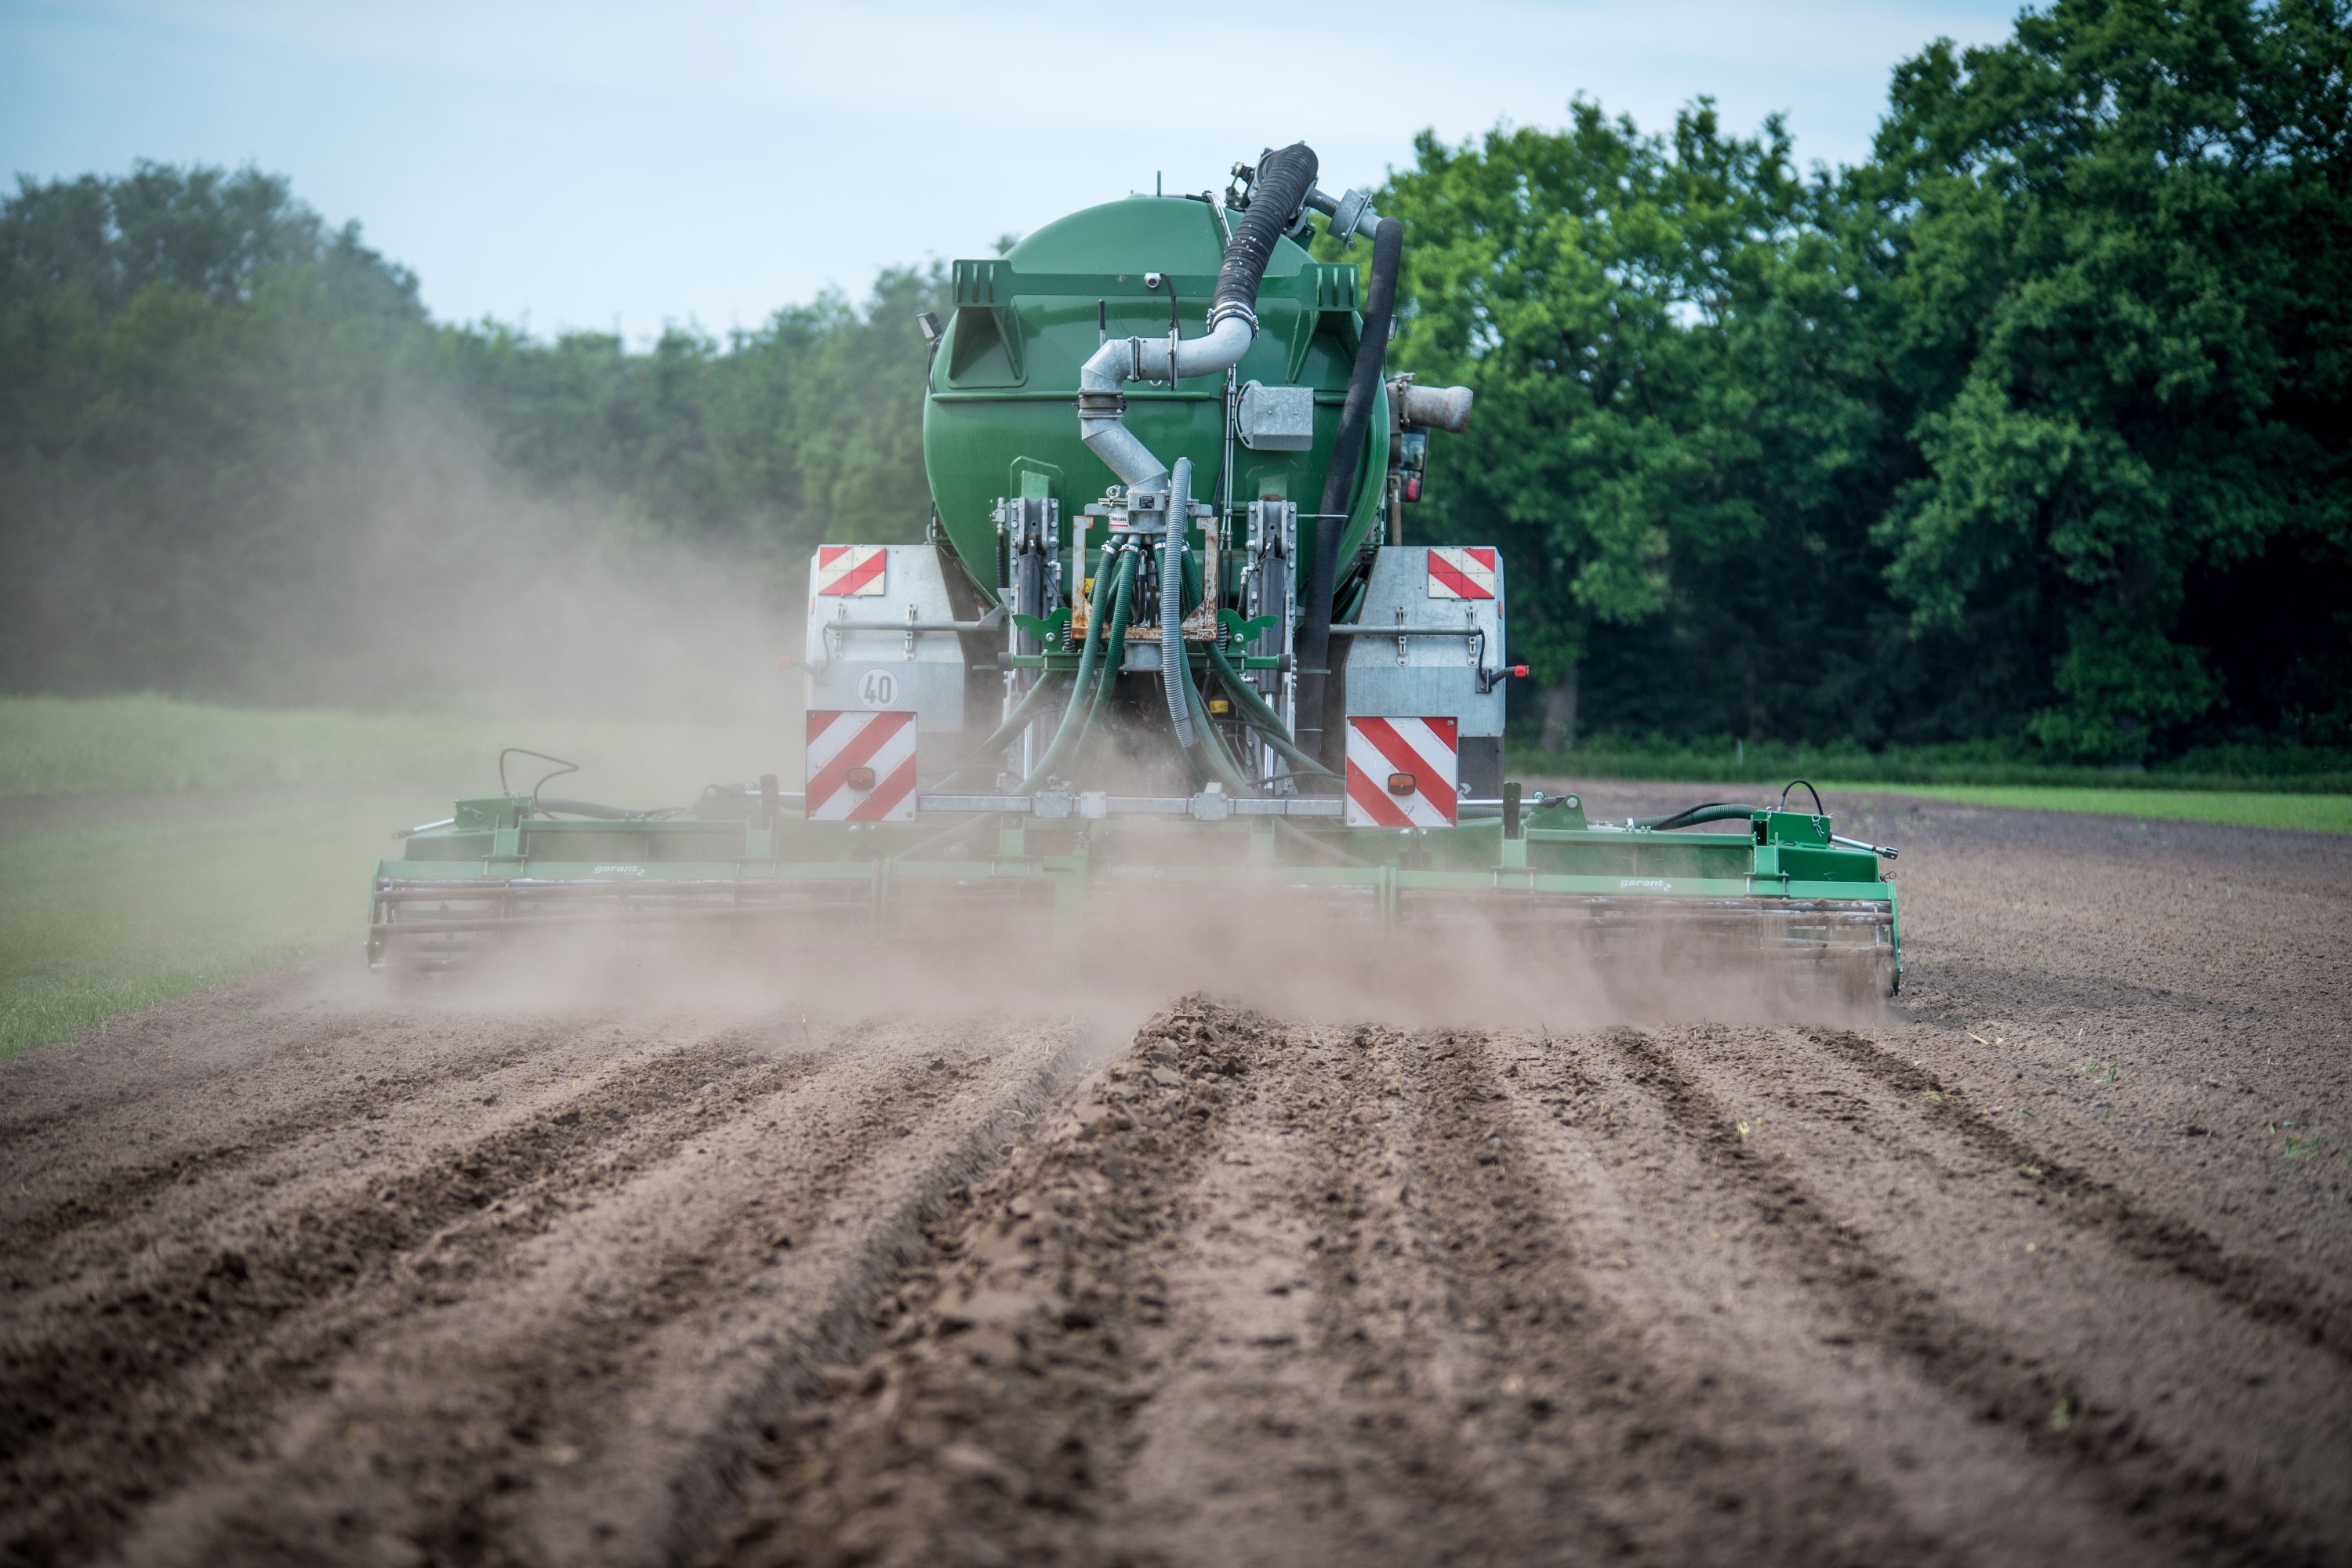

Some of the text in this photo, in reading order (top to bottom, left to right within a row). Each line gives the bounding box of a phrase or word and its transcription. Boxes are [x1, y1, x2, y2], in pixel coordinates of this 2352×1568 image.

[864, 674, 892, 704] 40
[593, 865, 639, 874] garant
[1620, 880, 1664, 888] garant
